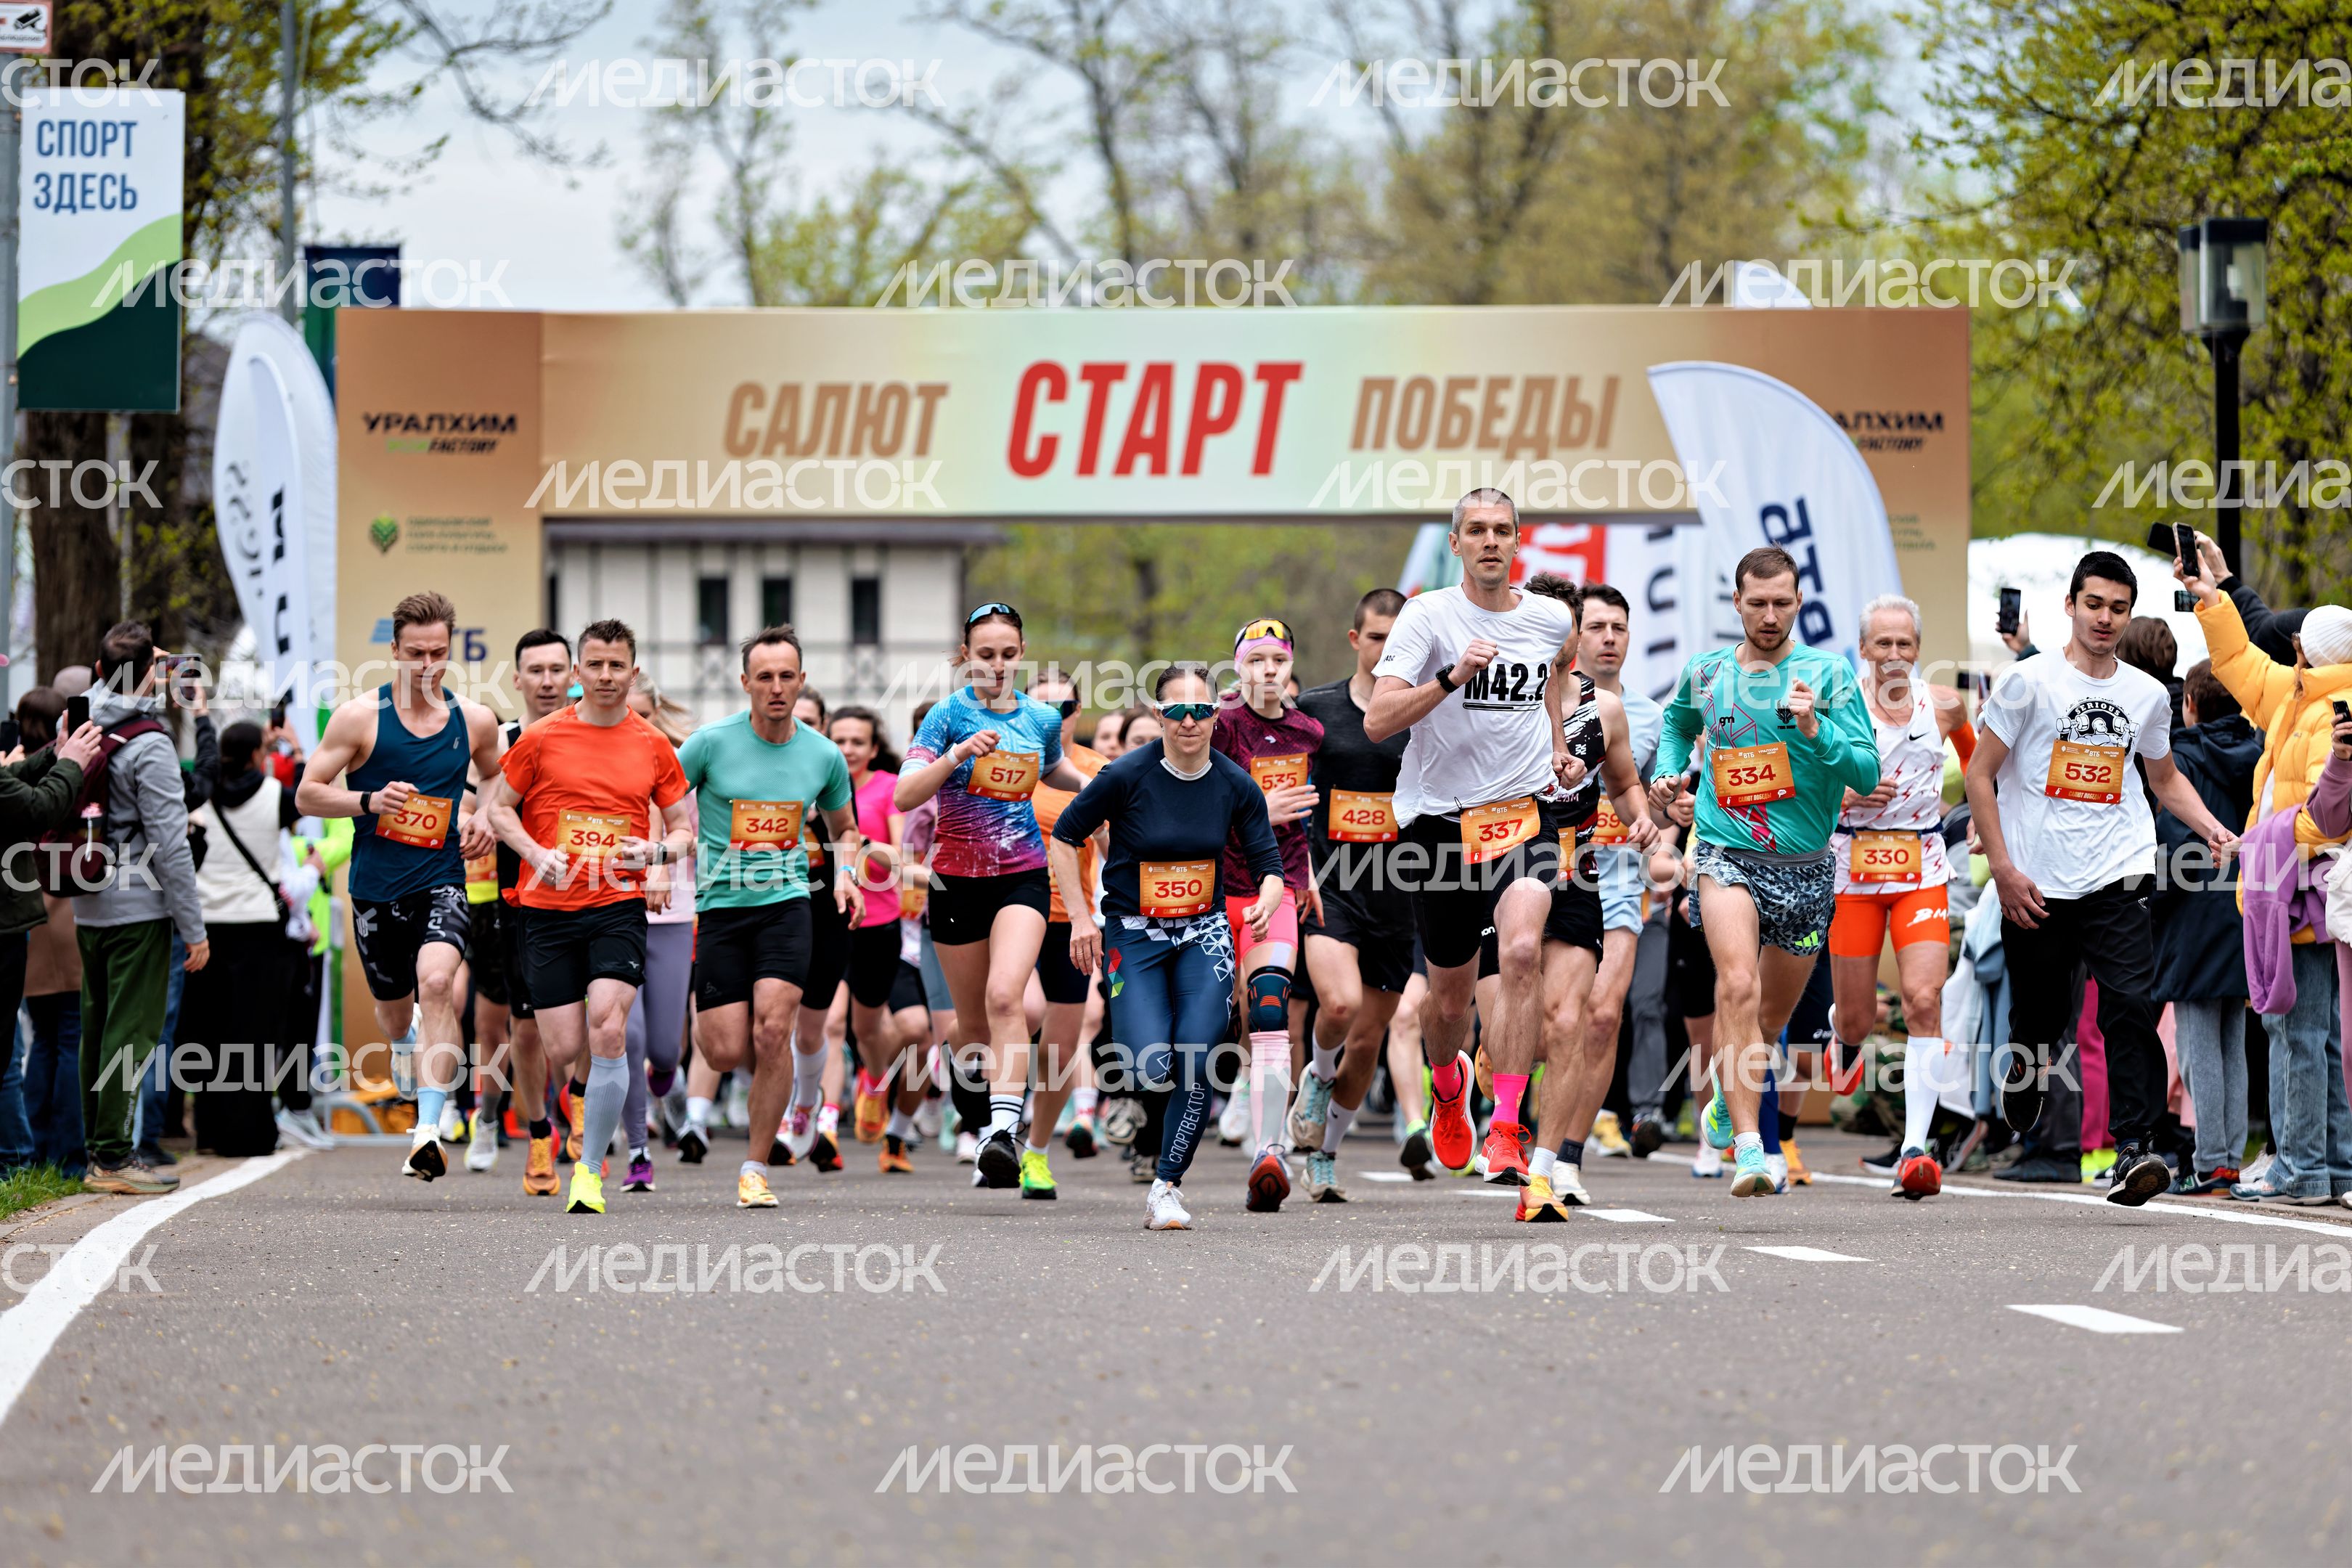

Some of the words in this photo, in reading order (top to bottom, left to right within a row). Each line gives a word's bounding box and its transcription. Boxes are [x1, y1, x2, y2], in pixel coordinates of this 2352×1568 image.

[37, 120, 138, 158] СПОРТ
[34, 172, 138, 213] ЗДЕСЬ
[362, 412, 518, 433] УРАЛХИМ
[724, 381, 949, 457] САЛЮТ
[1007, 360, 1304, 478] СТАРТ
[1349, 375, 1620, 460] ПОБЕДЫ
[1832, 412, 1944, 430] АЛХИМ
[2075, 701, 2120, 716] SERIOUS
[989, 767, 1026, 784] 517
[1727, 764, 1776, 787] 334
[2065, 762, 2112, 784] 532
[393, 808, 437, 830] 370
[746, 818, 788, 833] 342
[1342, 809, 1385, 825] 428
[1597, 812, 1621, 828] 69
[570, 829, 616, 848] 394
[1478, 818, 1523, 842] 337
[1863, 849, 1909, 865] 330
[1154, 879, 1203, 899] 350
[1169, 1082, 1205, 1164] СПОРТВЕКТОР
